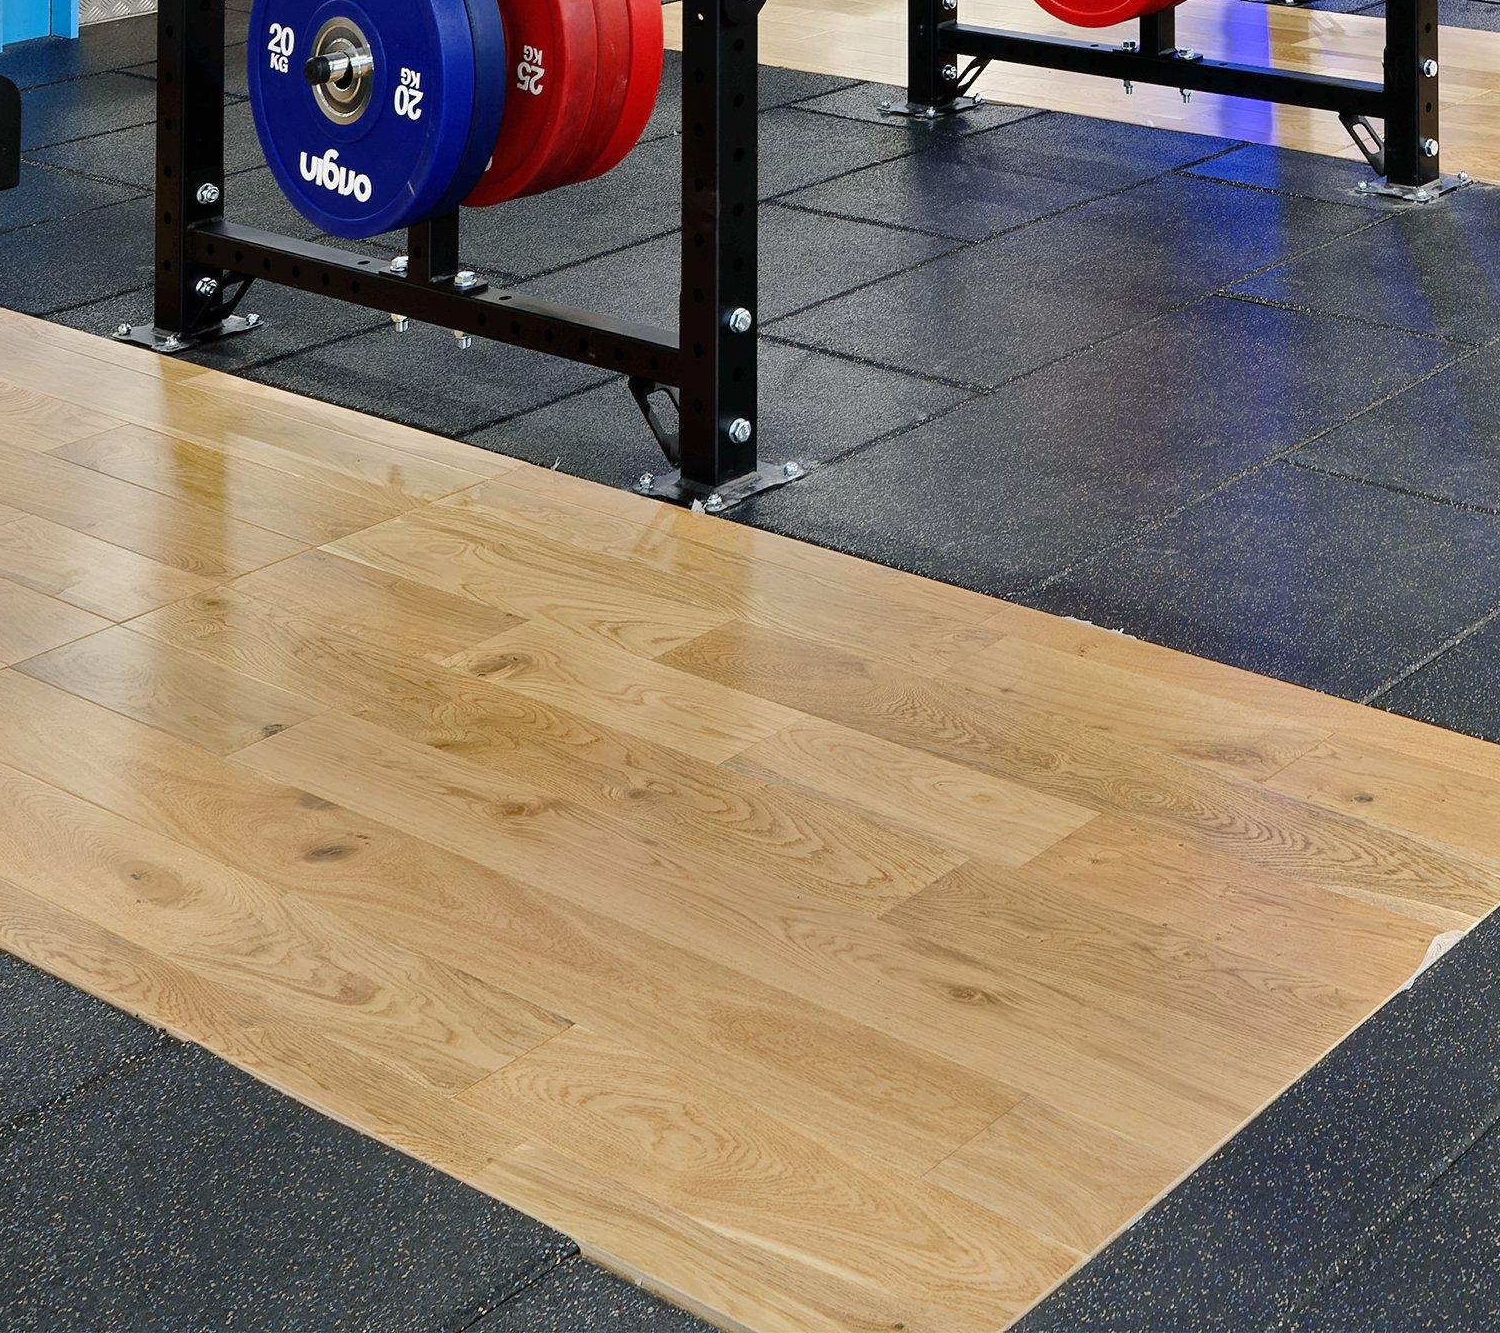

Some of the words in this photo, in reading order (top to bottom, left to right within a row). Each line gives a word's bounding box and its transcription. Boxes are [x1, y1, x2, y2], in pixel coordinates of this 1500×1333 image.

[268, 22, 294, 56] 20
[523, 45, 543, 65] KG
[269, 52, 289, 73] KG
[400, 67, 420, 89] KG
[517, 60, 544, 95] 25
[394, 85, 424, 121] 20
[300, 148, 372, 204] origin
